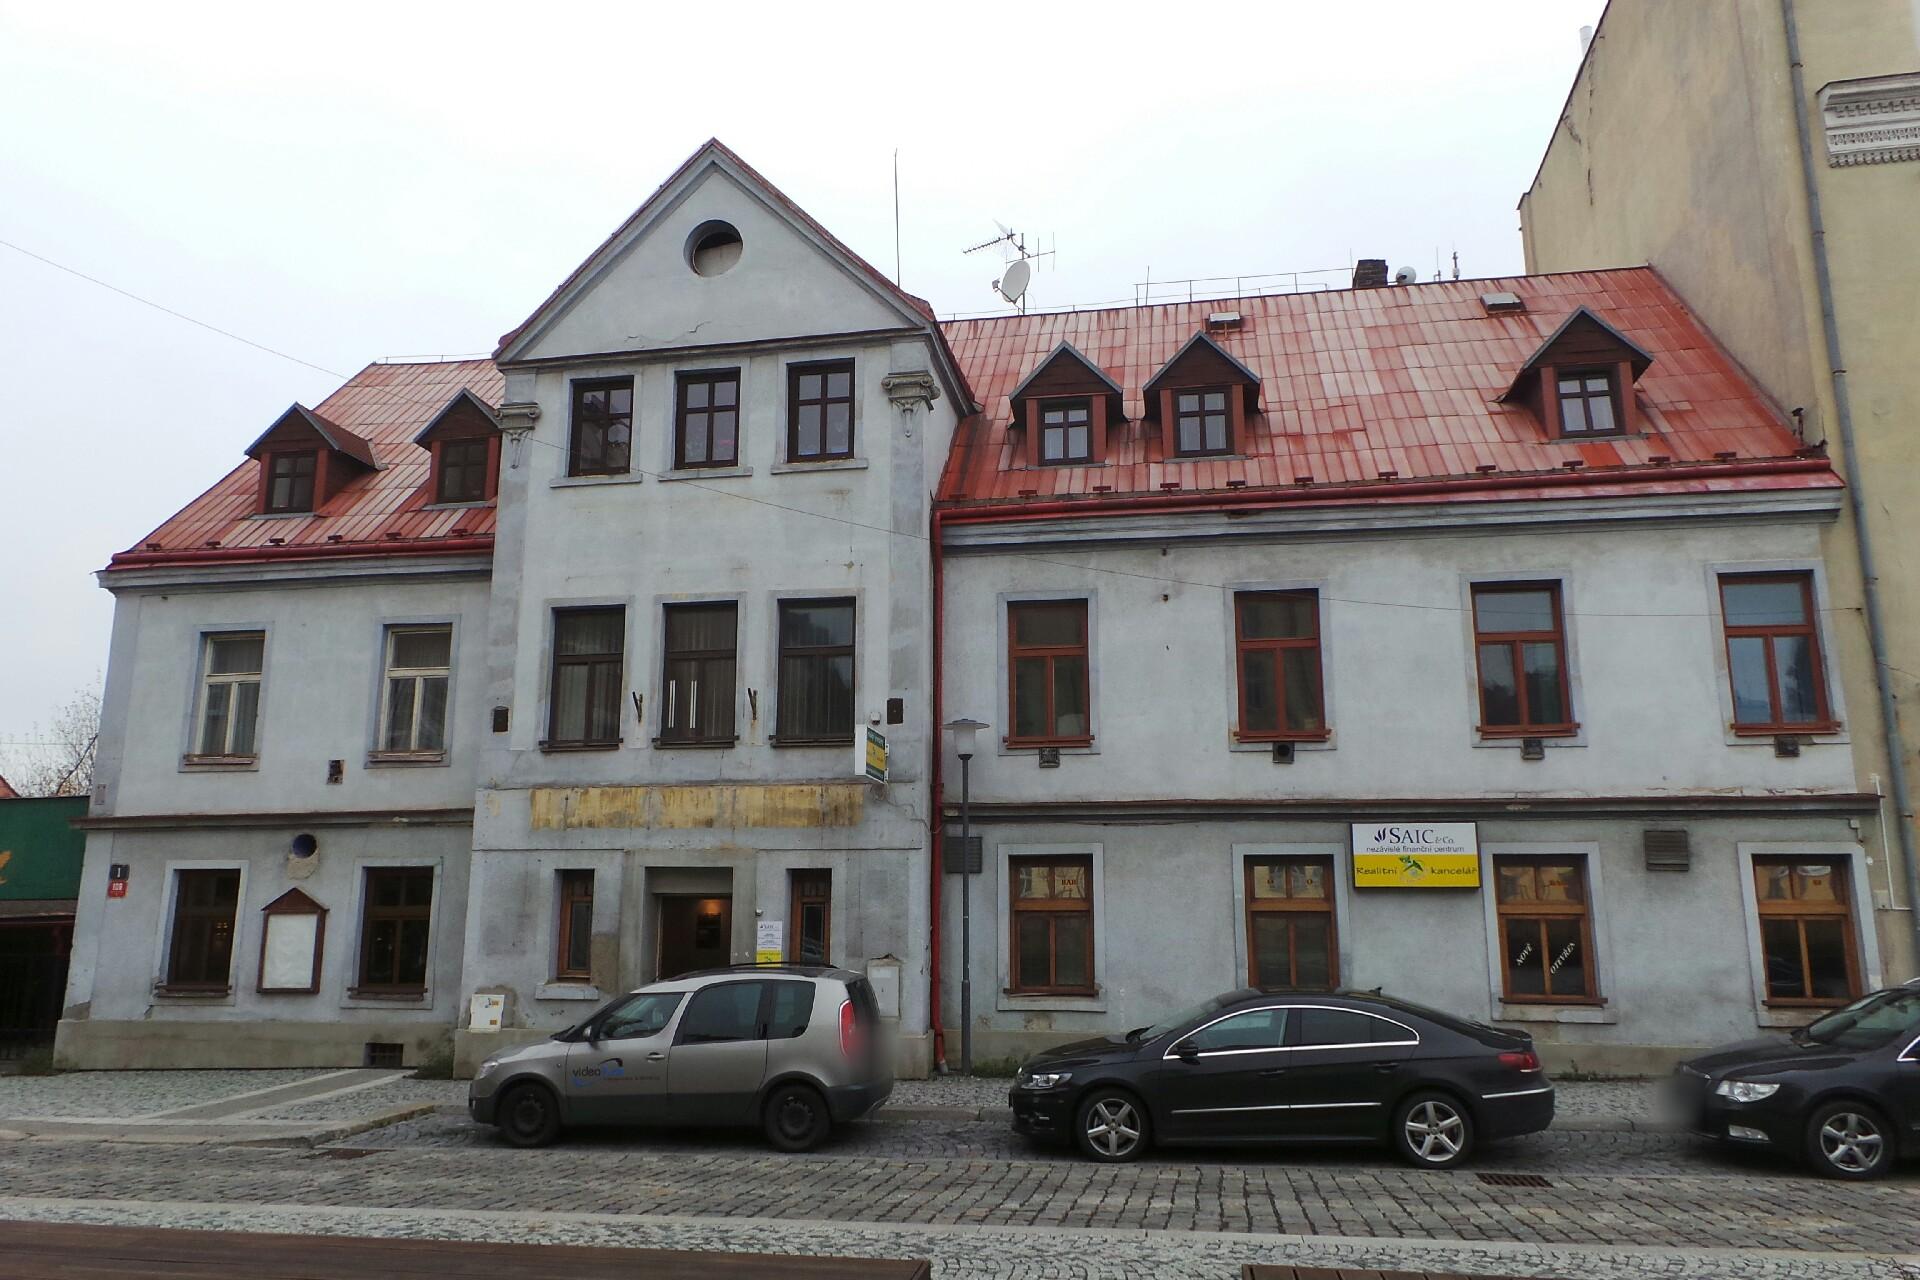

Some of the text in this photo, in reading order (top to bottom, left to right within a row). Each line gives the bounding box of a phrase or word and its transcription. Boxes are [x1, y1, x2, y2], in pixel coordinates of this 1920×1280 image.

[1389, 827, 1434, 844] SAIC
[1366, 844, 1464, 854] nezávislé finanční centrum
[1356, 866, 1477, 875] Realitní kancelář
[572, 1065, 601, 1077] video
